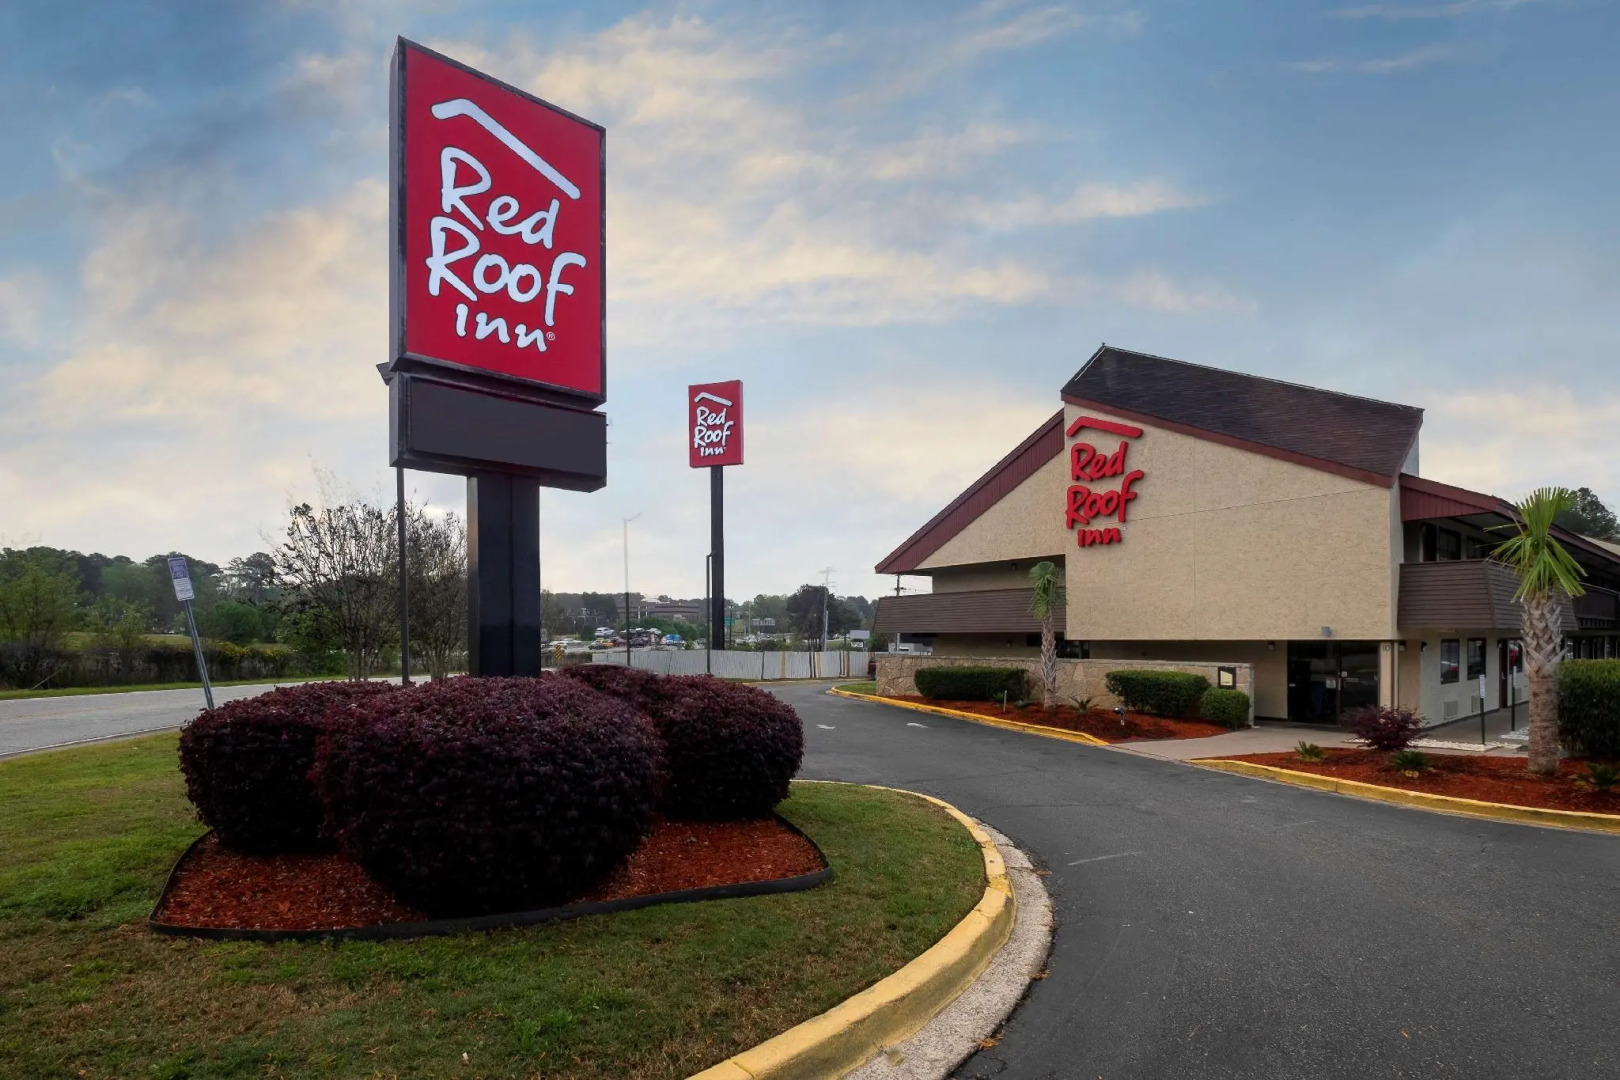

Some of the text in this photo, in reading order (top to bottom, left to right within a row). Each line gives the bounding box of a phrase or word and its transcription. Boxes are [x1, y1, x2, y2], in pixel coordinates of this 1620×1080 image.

[440, 147, 560, 248] Red
[425, 216, 587, 326] Roof
[694, 421, 734, 448] Roof
[697, 406, 727, 425] Red
[1071, 441, 1128, 481] Red
[1065, 470, 1144, 529] Roof
